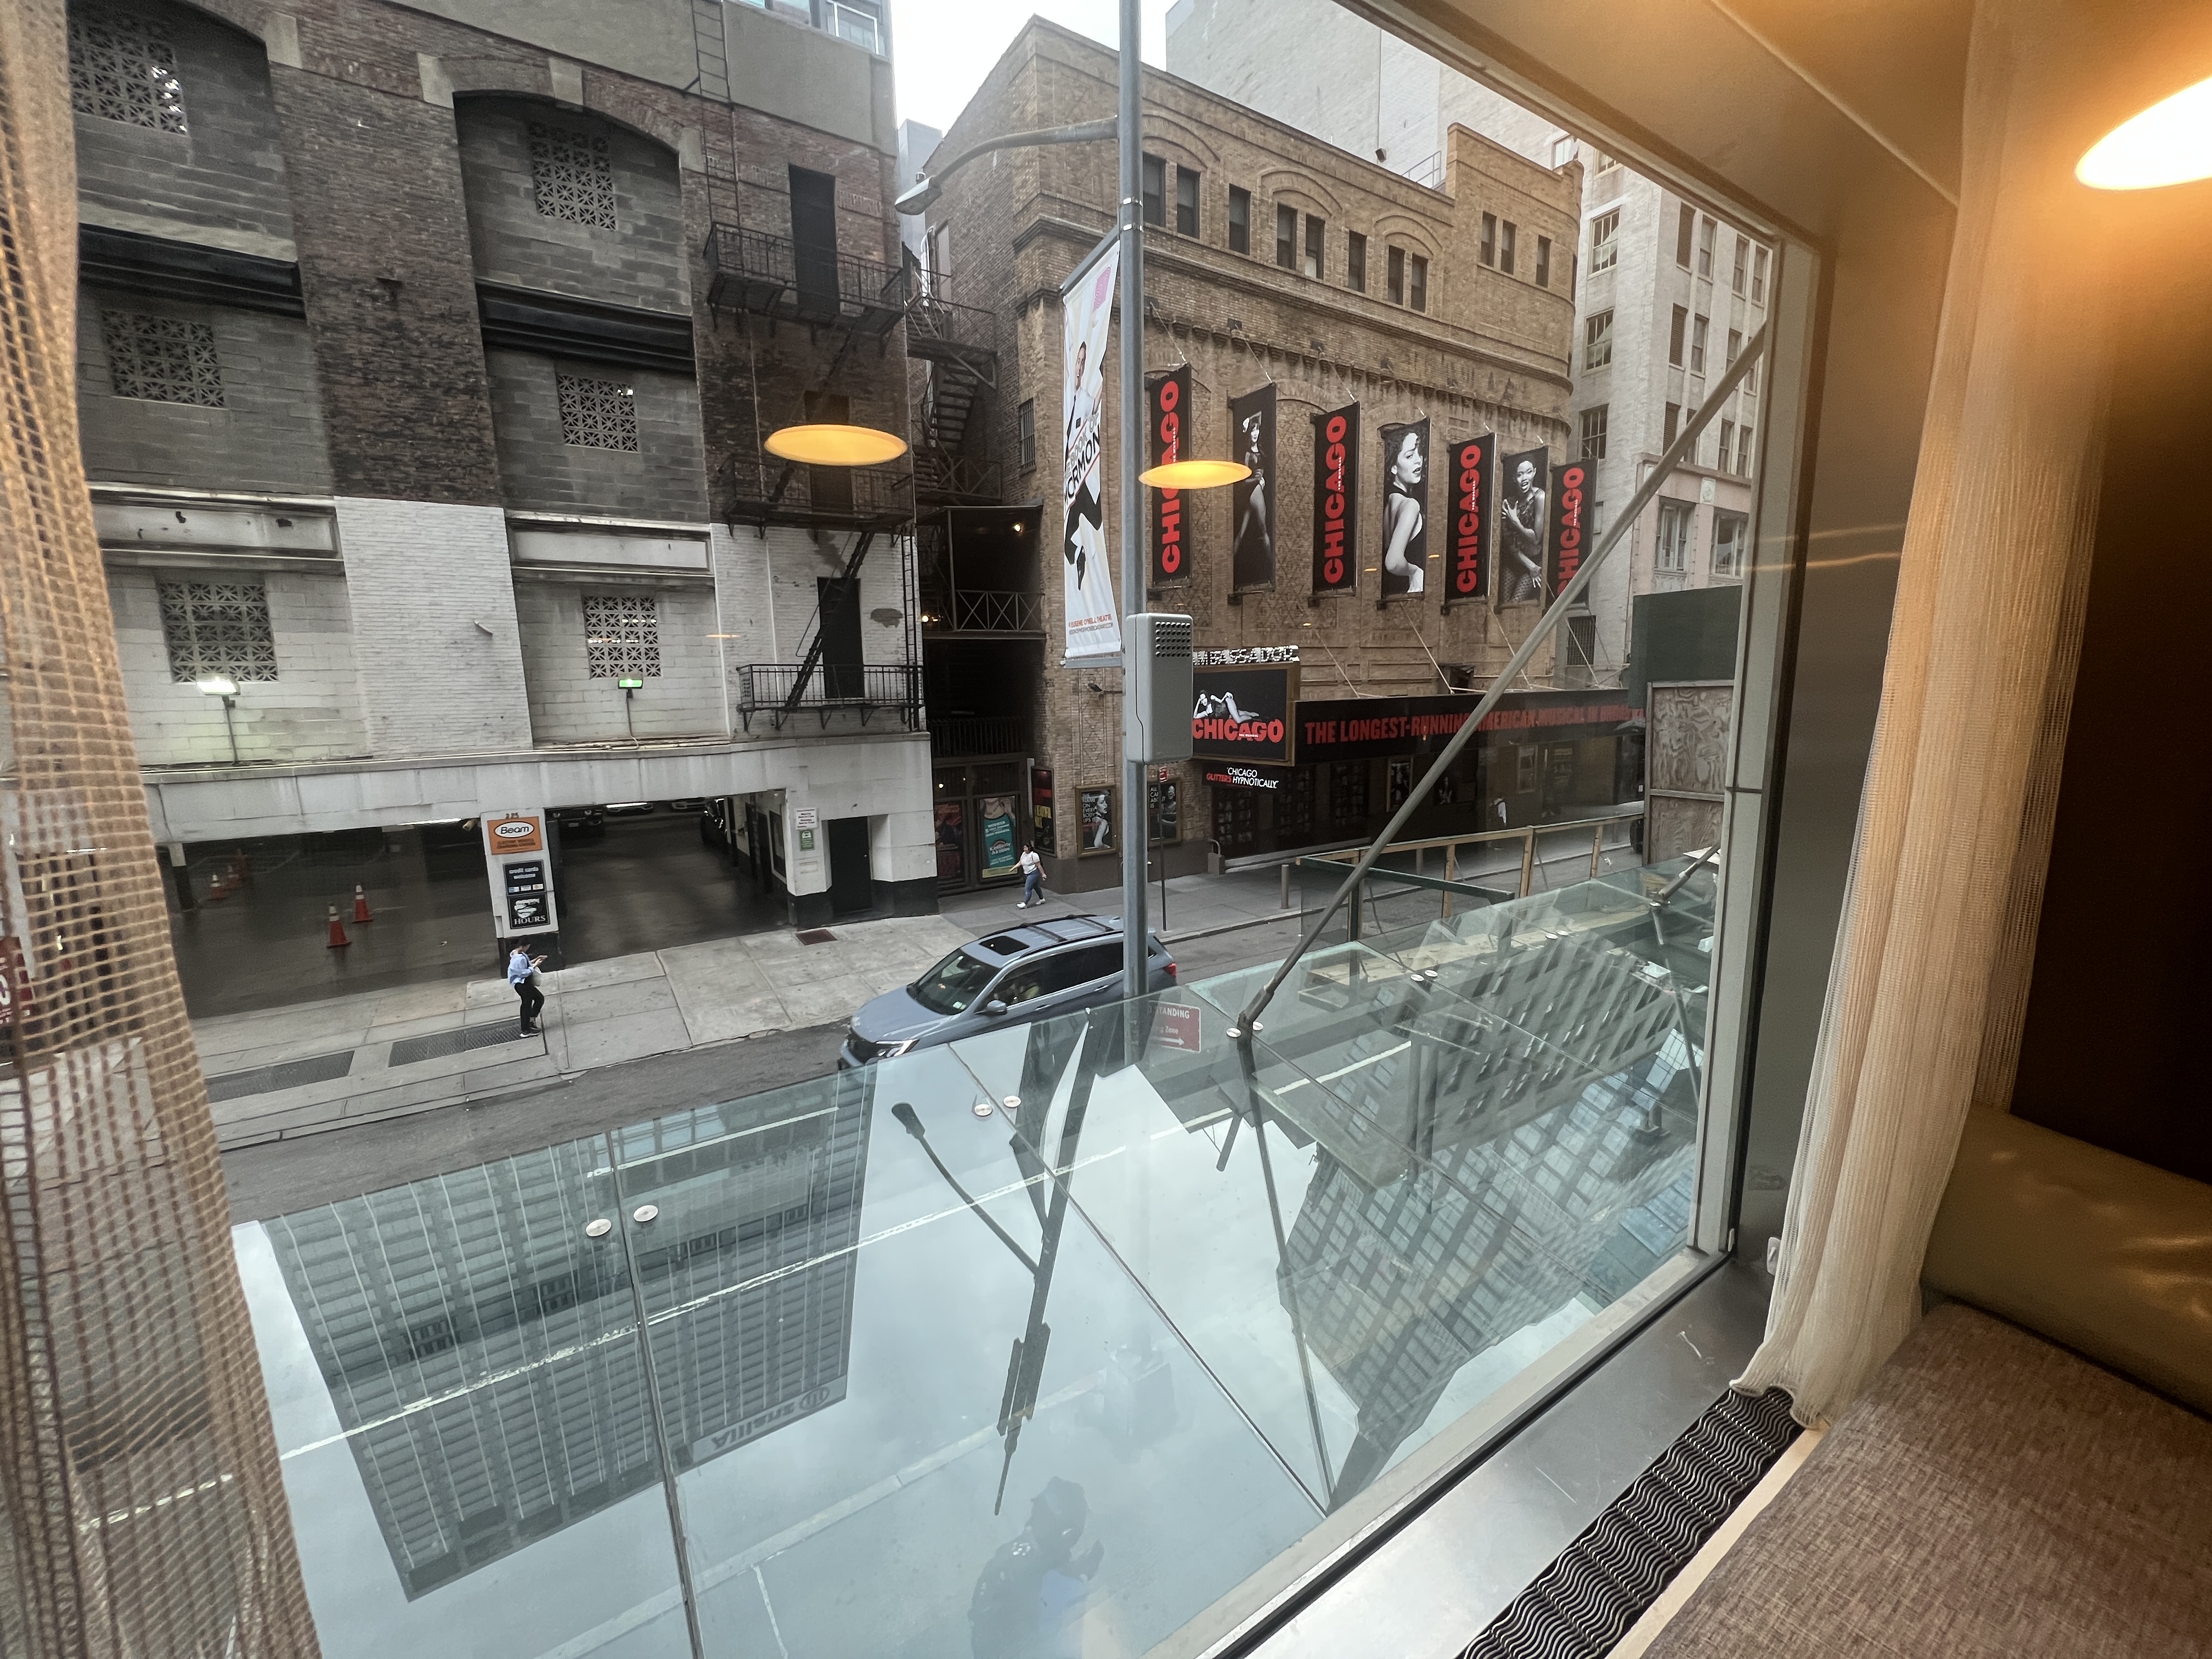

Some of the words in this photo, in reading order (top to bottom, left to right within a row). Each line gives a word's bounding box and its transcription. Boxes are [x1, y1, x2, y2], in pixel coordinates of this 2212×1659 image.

[1324, 415, 1347, 584] CHICAGO
[1456, 444, 1481, 593] CHICAGO
[1193, 718, 1284, 743] CHICAGO
[1304, 720, 1337, 745] THE
[1477, 709, 1537, 732] MERICAN
[500, 826, 529, 834] Beam
[514, 915, 546, 925] HOURS
[1155, 1006, 1190, 1019] STANDING
[1165, 1025, 1178, 1034] Zone
